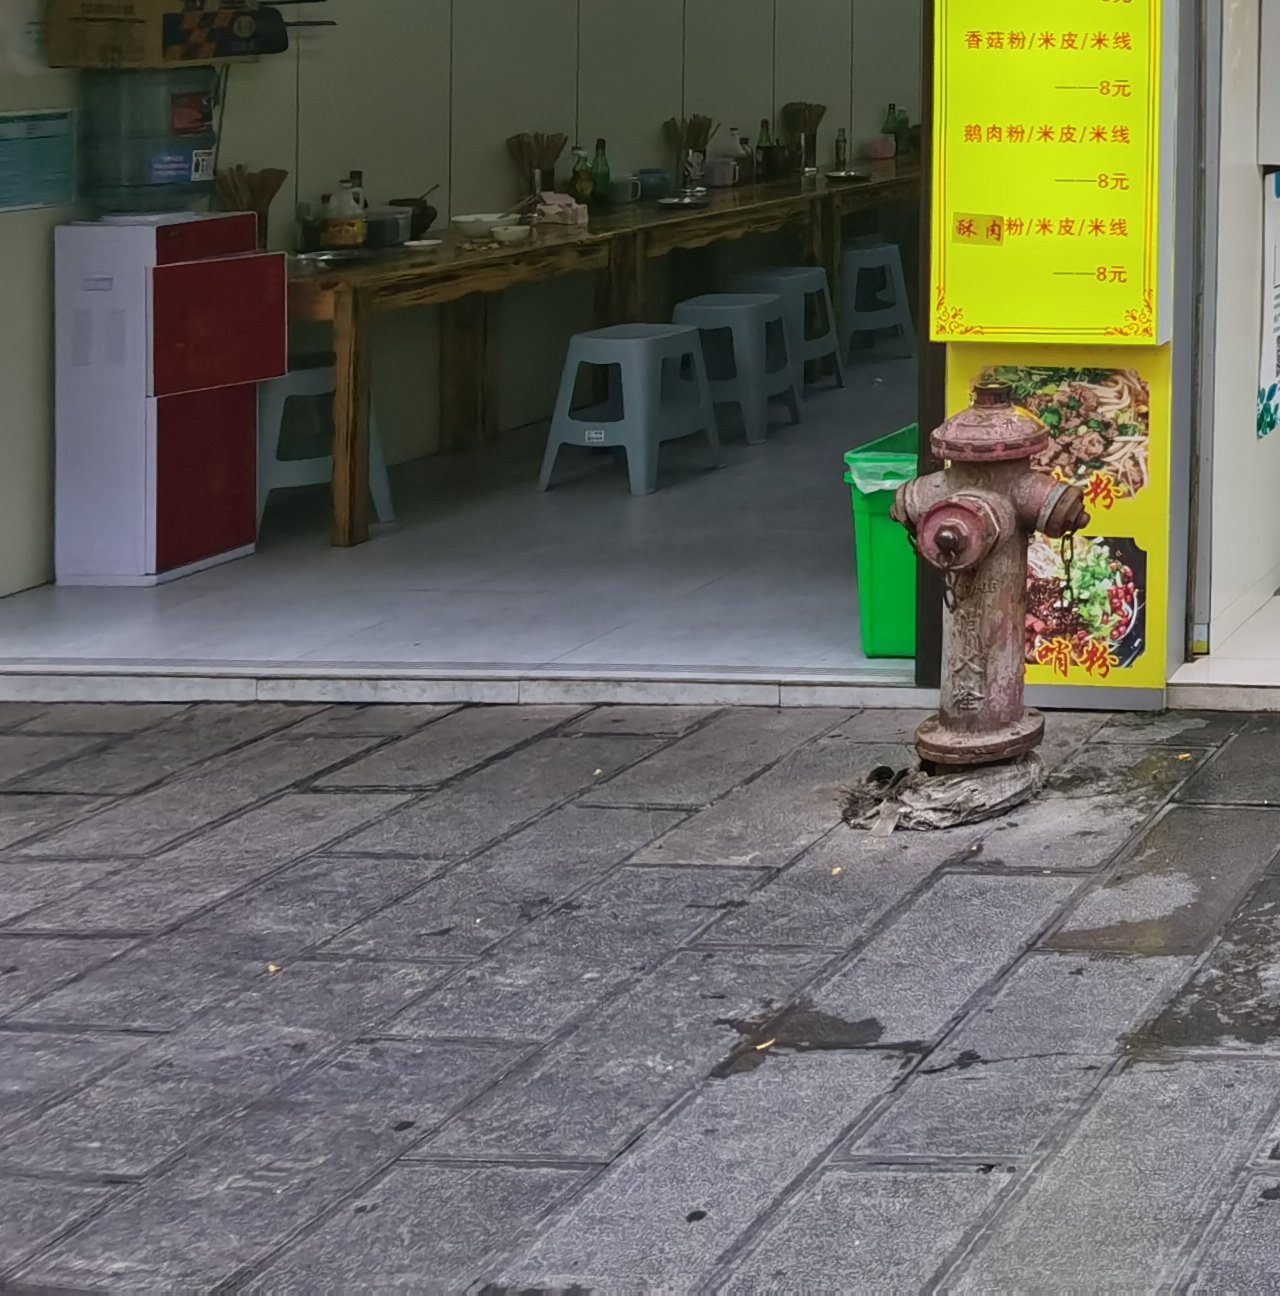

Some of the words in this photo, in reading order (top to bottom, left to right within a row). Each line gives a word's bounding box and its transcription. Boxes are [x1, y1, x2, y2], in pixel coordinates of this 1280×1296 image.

[965, 31, 1133, 51] 香菇粉/米皮/米线
[964, 124, 1131, 145] 鹅肉粉/米皮/米线
[1032, 638, 1120, 680] 哨粉
